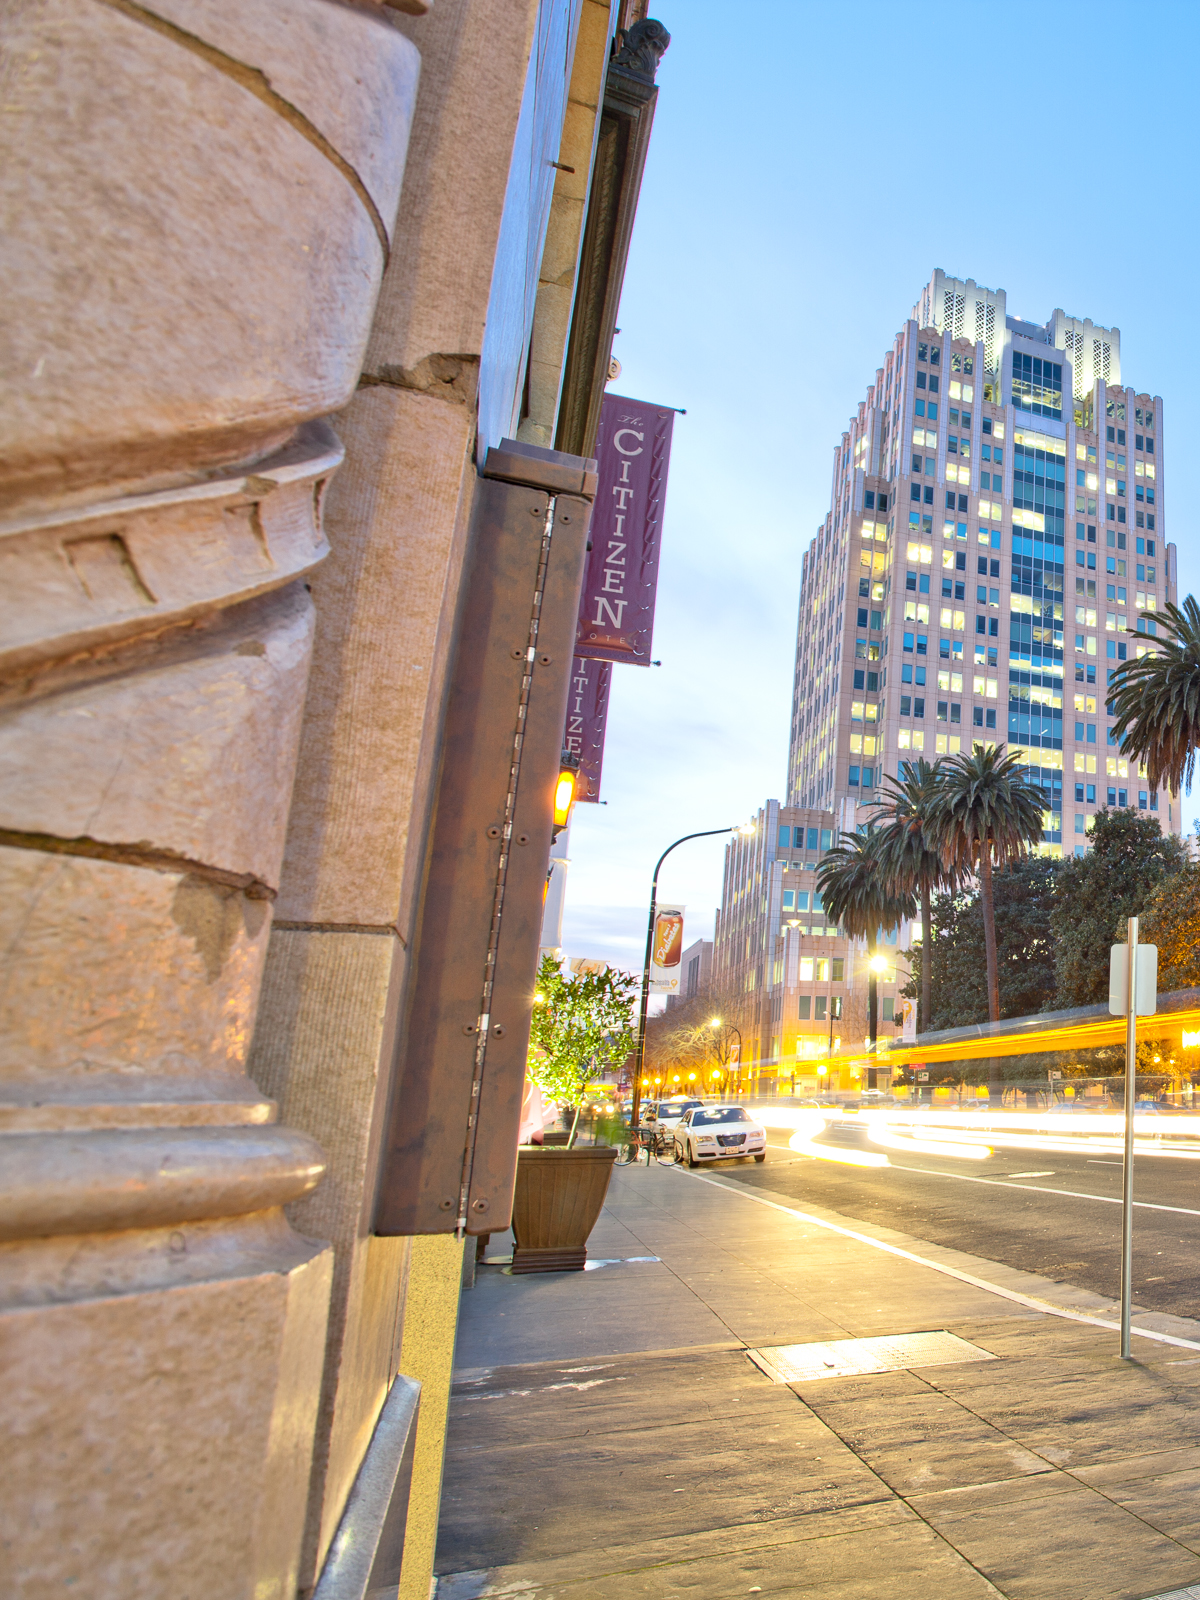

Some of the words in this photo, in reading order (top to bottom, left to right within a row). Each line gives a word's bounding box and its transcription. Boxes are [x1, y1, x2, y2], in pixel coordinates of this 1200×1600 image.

[617, 414, 644, 427] The
[591, 428, 645, 629] CITIZEN
[566, 658, 589, 777] ITIZE
[656, 922, 680, 961] Diabetes
